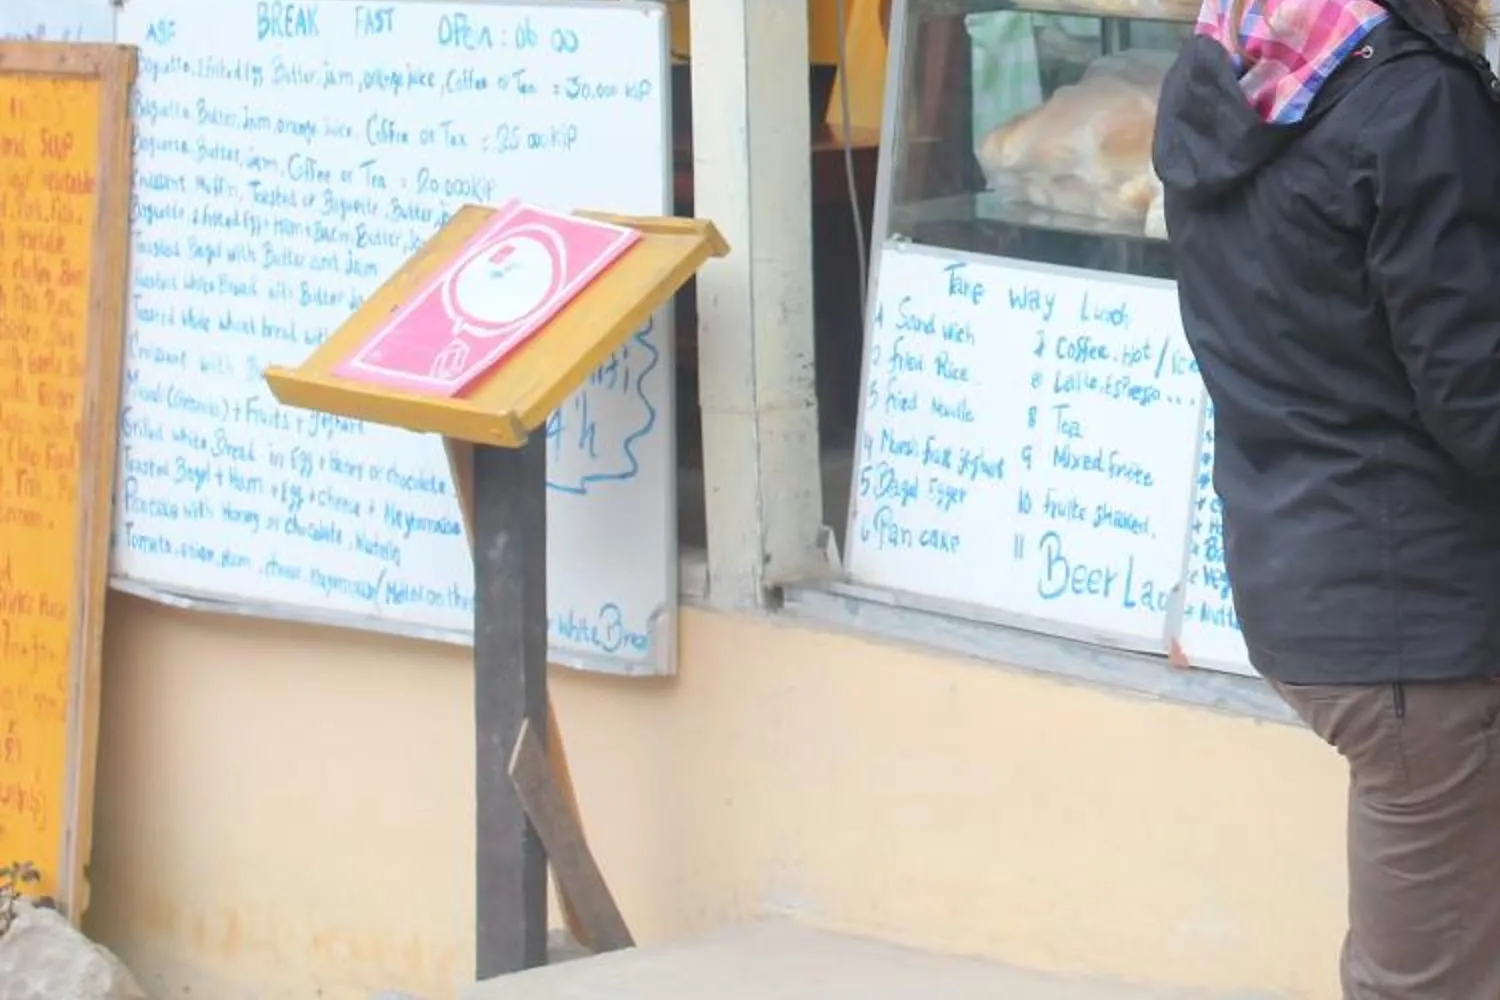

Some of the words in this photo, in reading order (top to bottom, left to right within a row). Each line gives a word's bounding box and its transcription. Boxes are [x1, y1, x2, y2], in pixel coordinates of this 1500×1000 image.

[256, 0, 320, 41] BREAK
[355, 5, 396, 39] FAST
[1037, 530, 1118, 600] Beer
